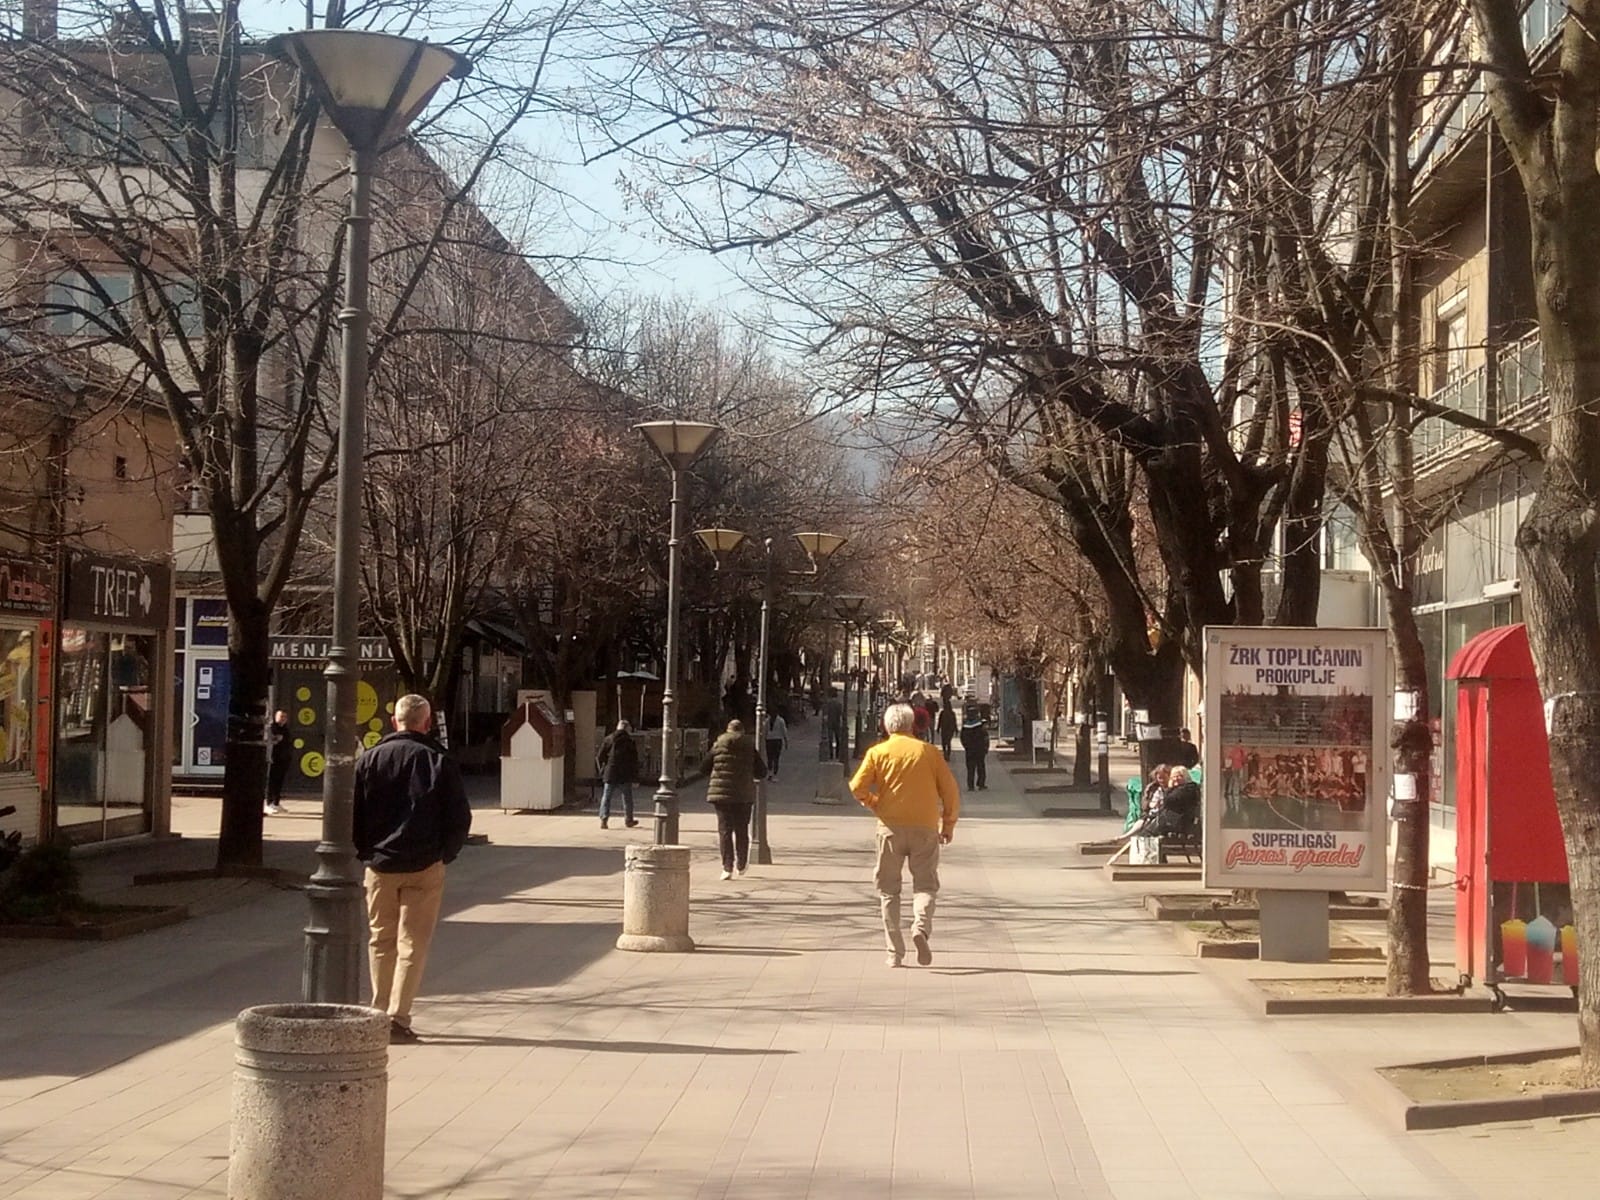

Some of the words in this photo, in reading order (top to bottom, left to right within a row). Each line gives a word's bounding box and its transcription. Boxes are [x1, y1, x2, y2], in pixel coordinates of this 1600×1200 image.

[90, 565, 137, 617] TREF
[272, 643, 395, 658] MENJNI
[1230, 644, 1261, 666] ŽRK
[1268, 645, 1363, 667] TOPLIČANIN
[280, 663, 328, 671] EXCHANG
[1256, 668, 1336, 684] PROKUPLJE
[1252, 831, 1337, 848] SUPERLIGAŠI
[1226, 841, 1287, 868] Ponos
[1289, 842, 1366, 873] grada!
